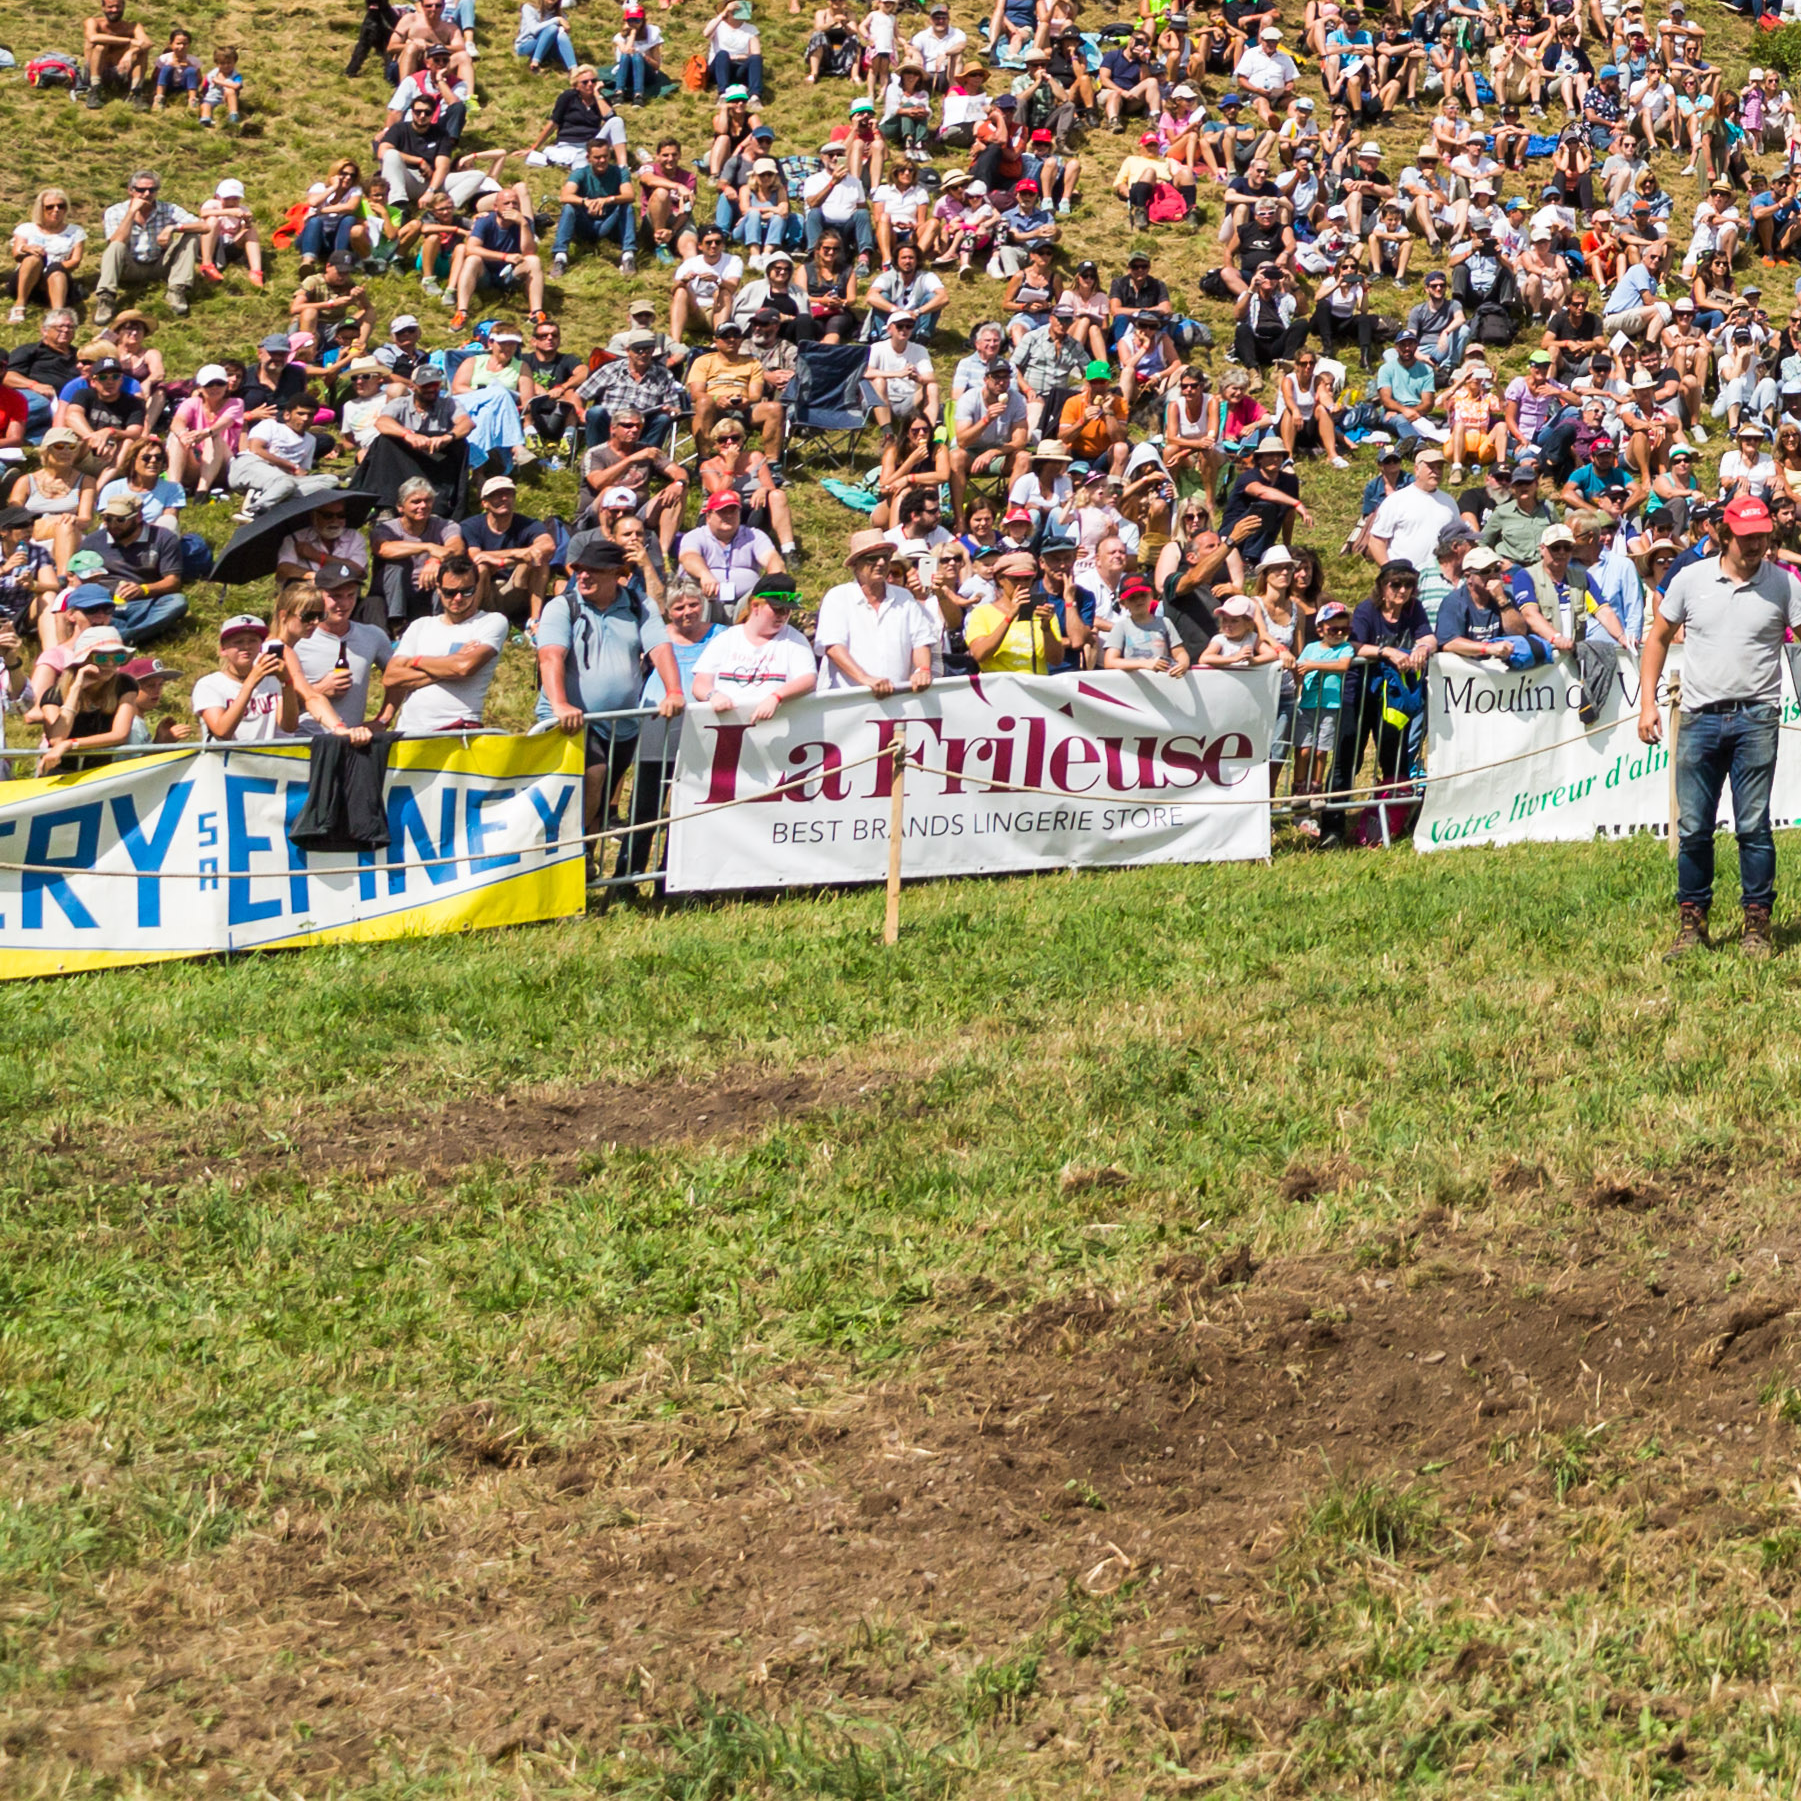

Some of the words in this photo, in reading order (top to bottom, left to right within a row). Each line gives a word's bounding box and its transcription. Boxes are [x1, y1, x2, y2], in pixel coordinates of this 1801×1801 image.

[1443, 675, 1556, 714] Moulin
[694, 723, 852, 805] La
[860, 715, 1253, 799] Frileuse
[772, 820, 843, 844] BEST
[974, 810, 1093, 834] LINGERIE
[1102, 806, 1184, 830] STORE
[1431, 809, 1501, 844] Votre
[1508, 775, 1597, 823] livreur
